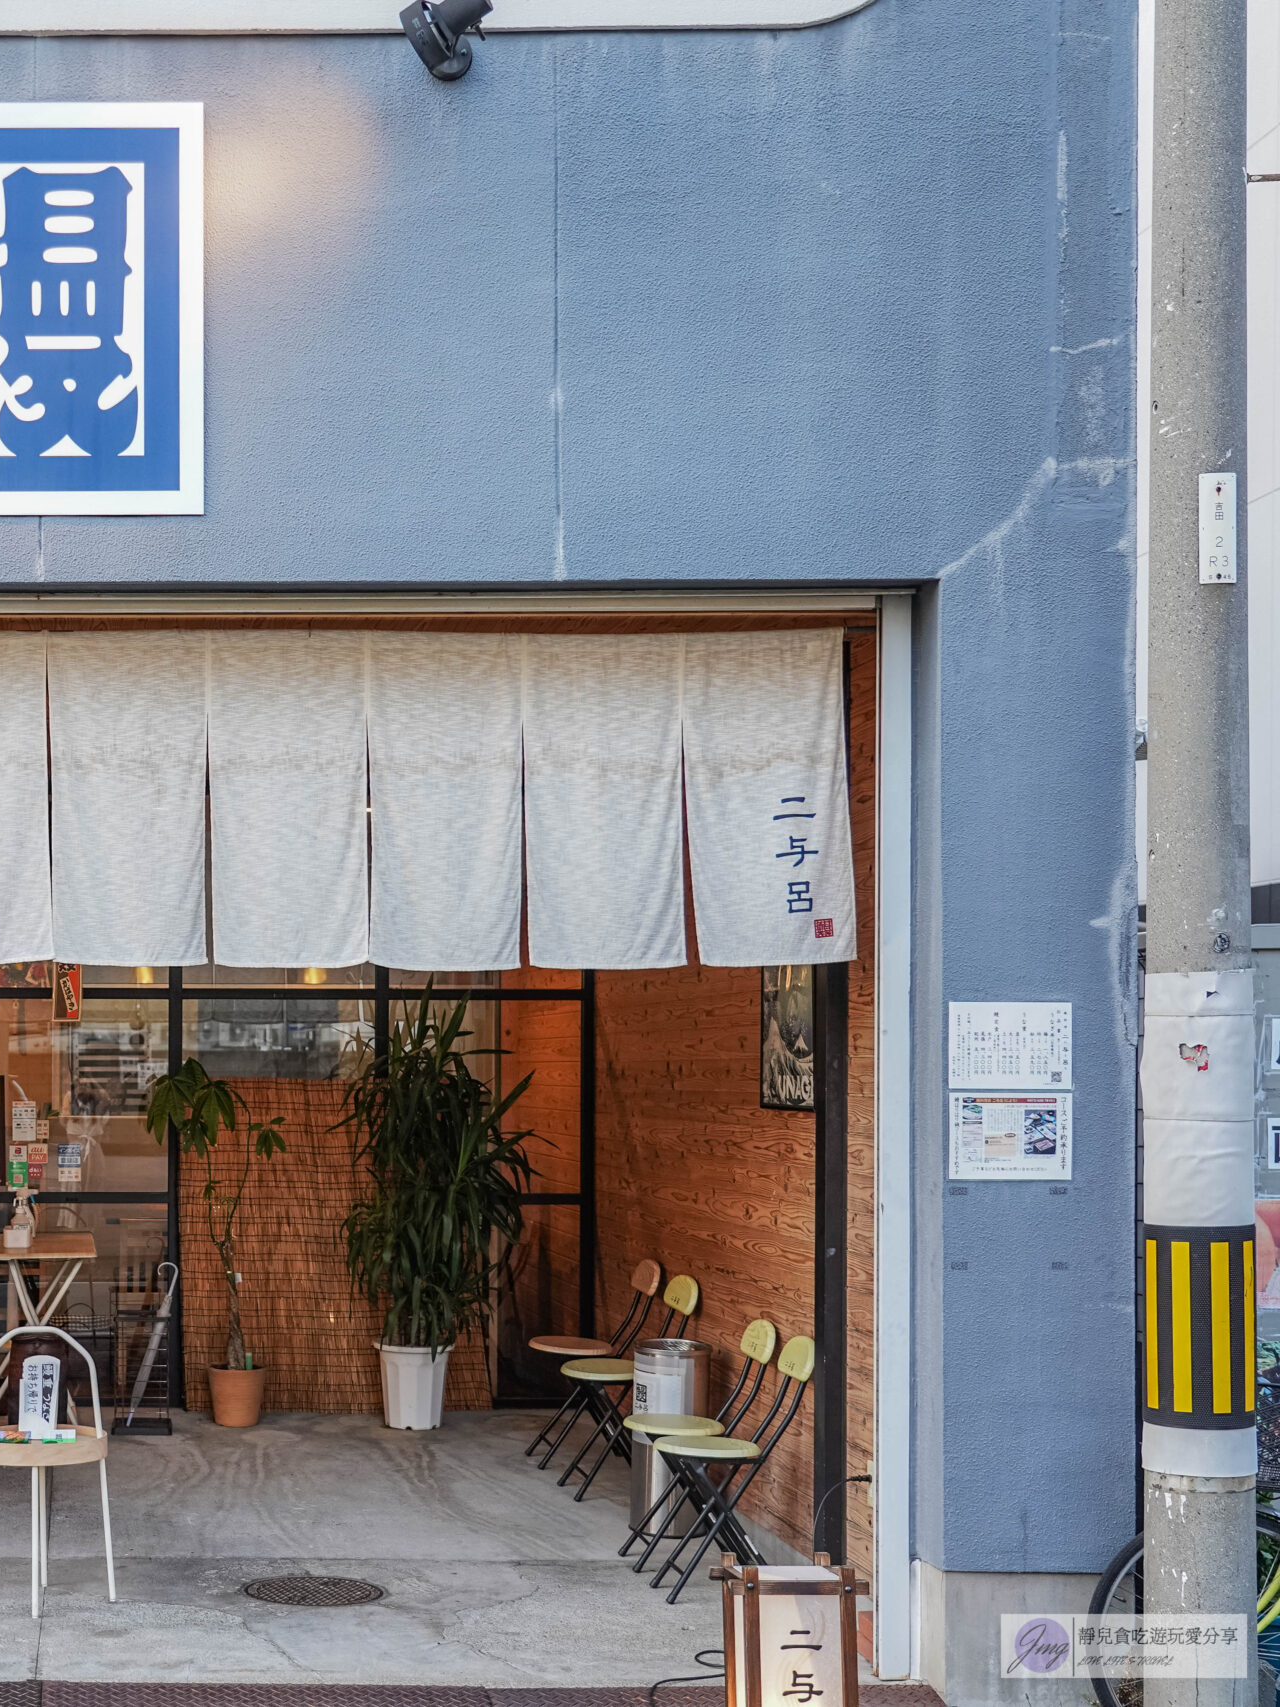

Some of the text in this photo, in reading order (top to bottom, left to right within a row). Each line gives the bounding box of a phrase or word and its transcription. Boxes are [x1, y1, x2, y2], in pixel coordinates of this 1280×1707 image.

[1216, 536, 1224, 548] 2
[772, 796, 819, 914] 二与呂
[780, 1629, 824, 1704] 二与
